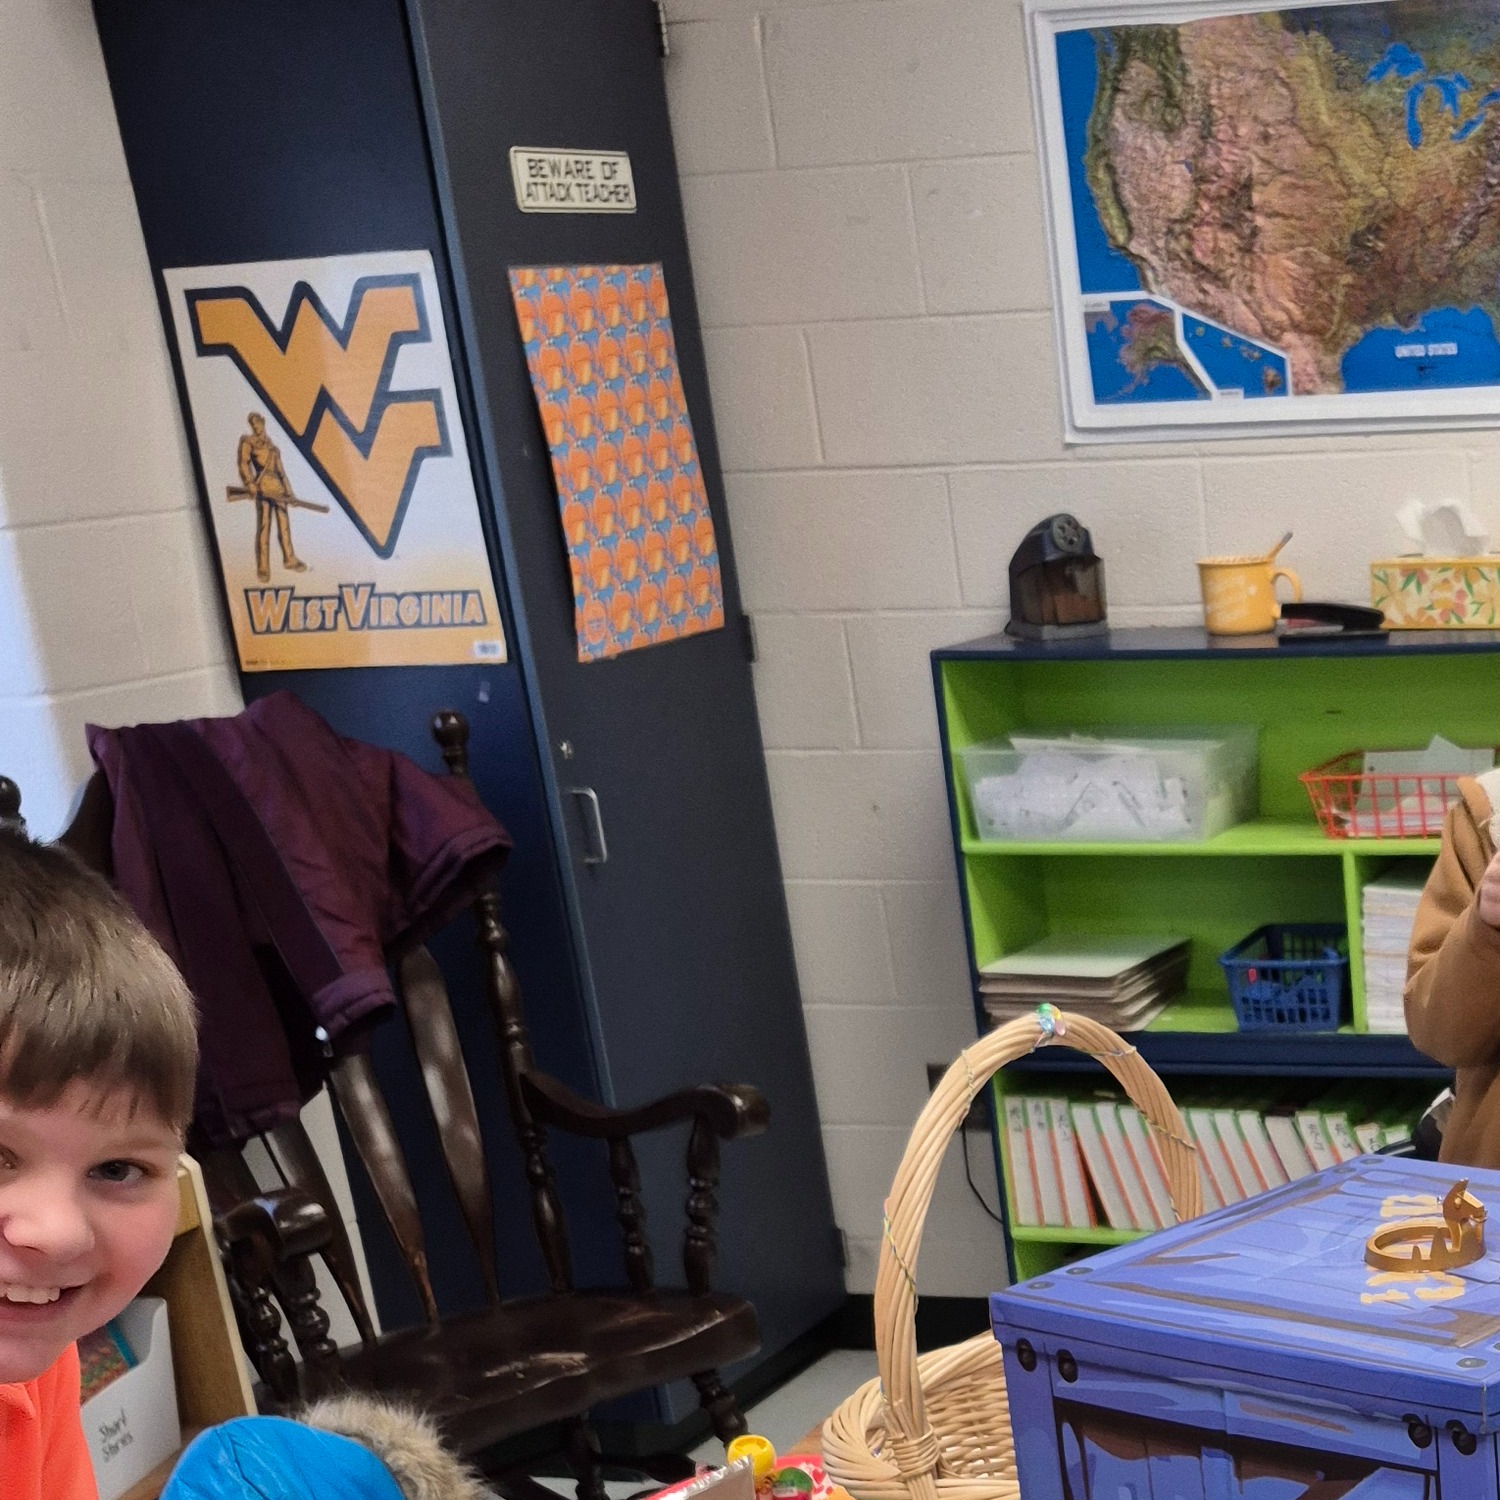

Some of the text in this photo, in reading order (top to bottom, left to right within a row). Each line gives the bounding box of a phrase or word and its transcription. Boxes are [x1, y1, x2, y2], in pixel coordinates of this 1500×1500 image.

[527, 158, 619, 181] BEWARE OF
[526, 181, 634, 204] ATTACK TEACHER
